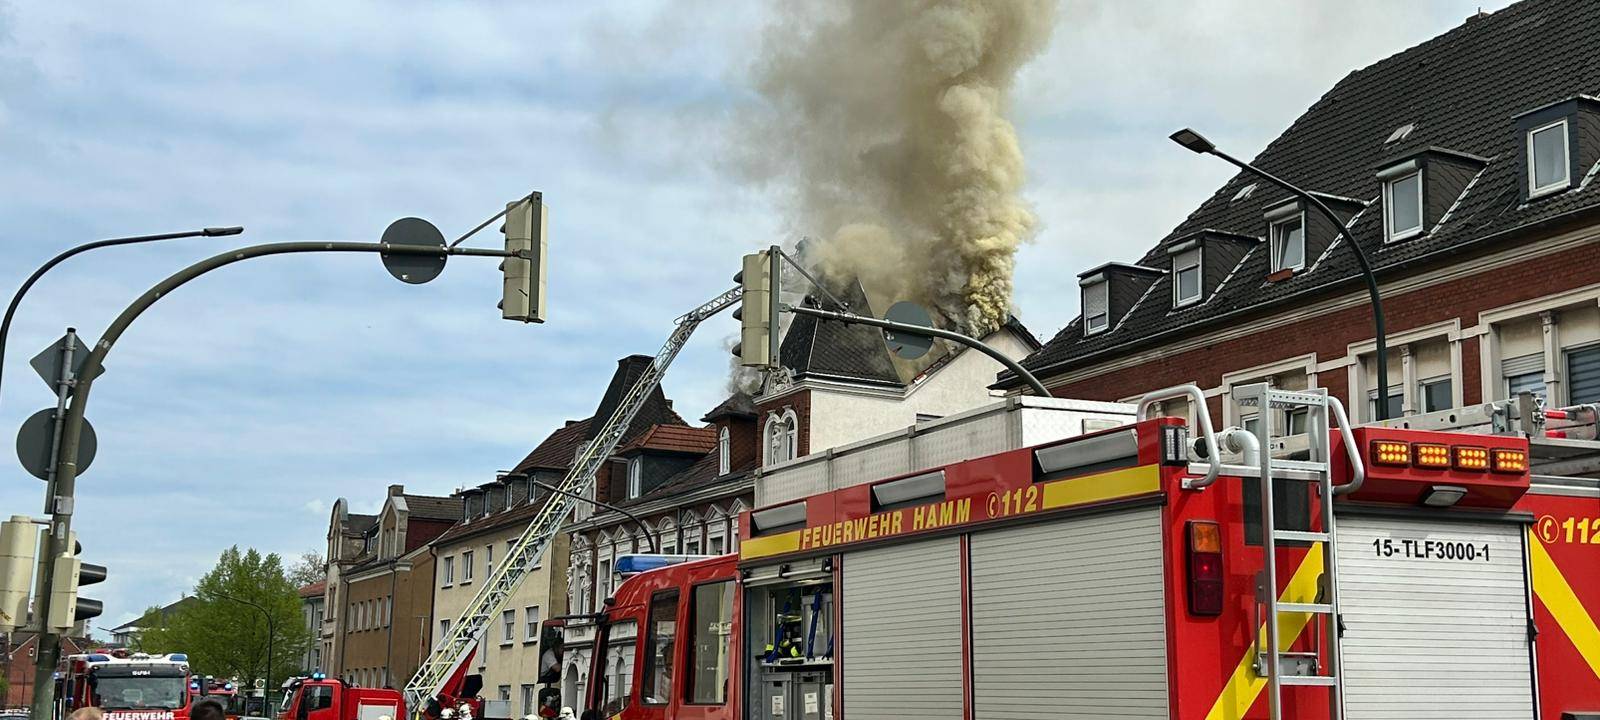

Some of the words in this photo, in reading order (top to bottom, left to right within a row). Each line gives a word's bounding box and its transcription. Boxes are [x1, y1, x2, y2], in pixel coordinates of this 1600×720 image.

[802, 511, 903, 550] FEUERWEHR
[913, 498, 971, 530] HAMM
[1002, 485, 1038, 516] 112
[1563, 517, 1600, 544] 112
[1373, 539, 1490, 561] 15-TLF3000-1
[102, 711, 175, 720] FEUERWEHR
